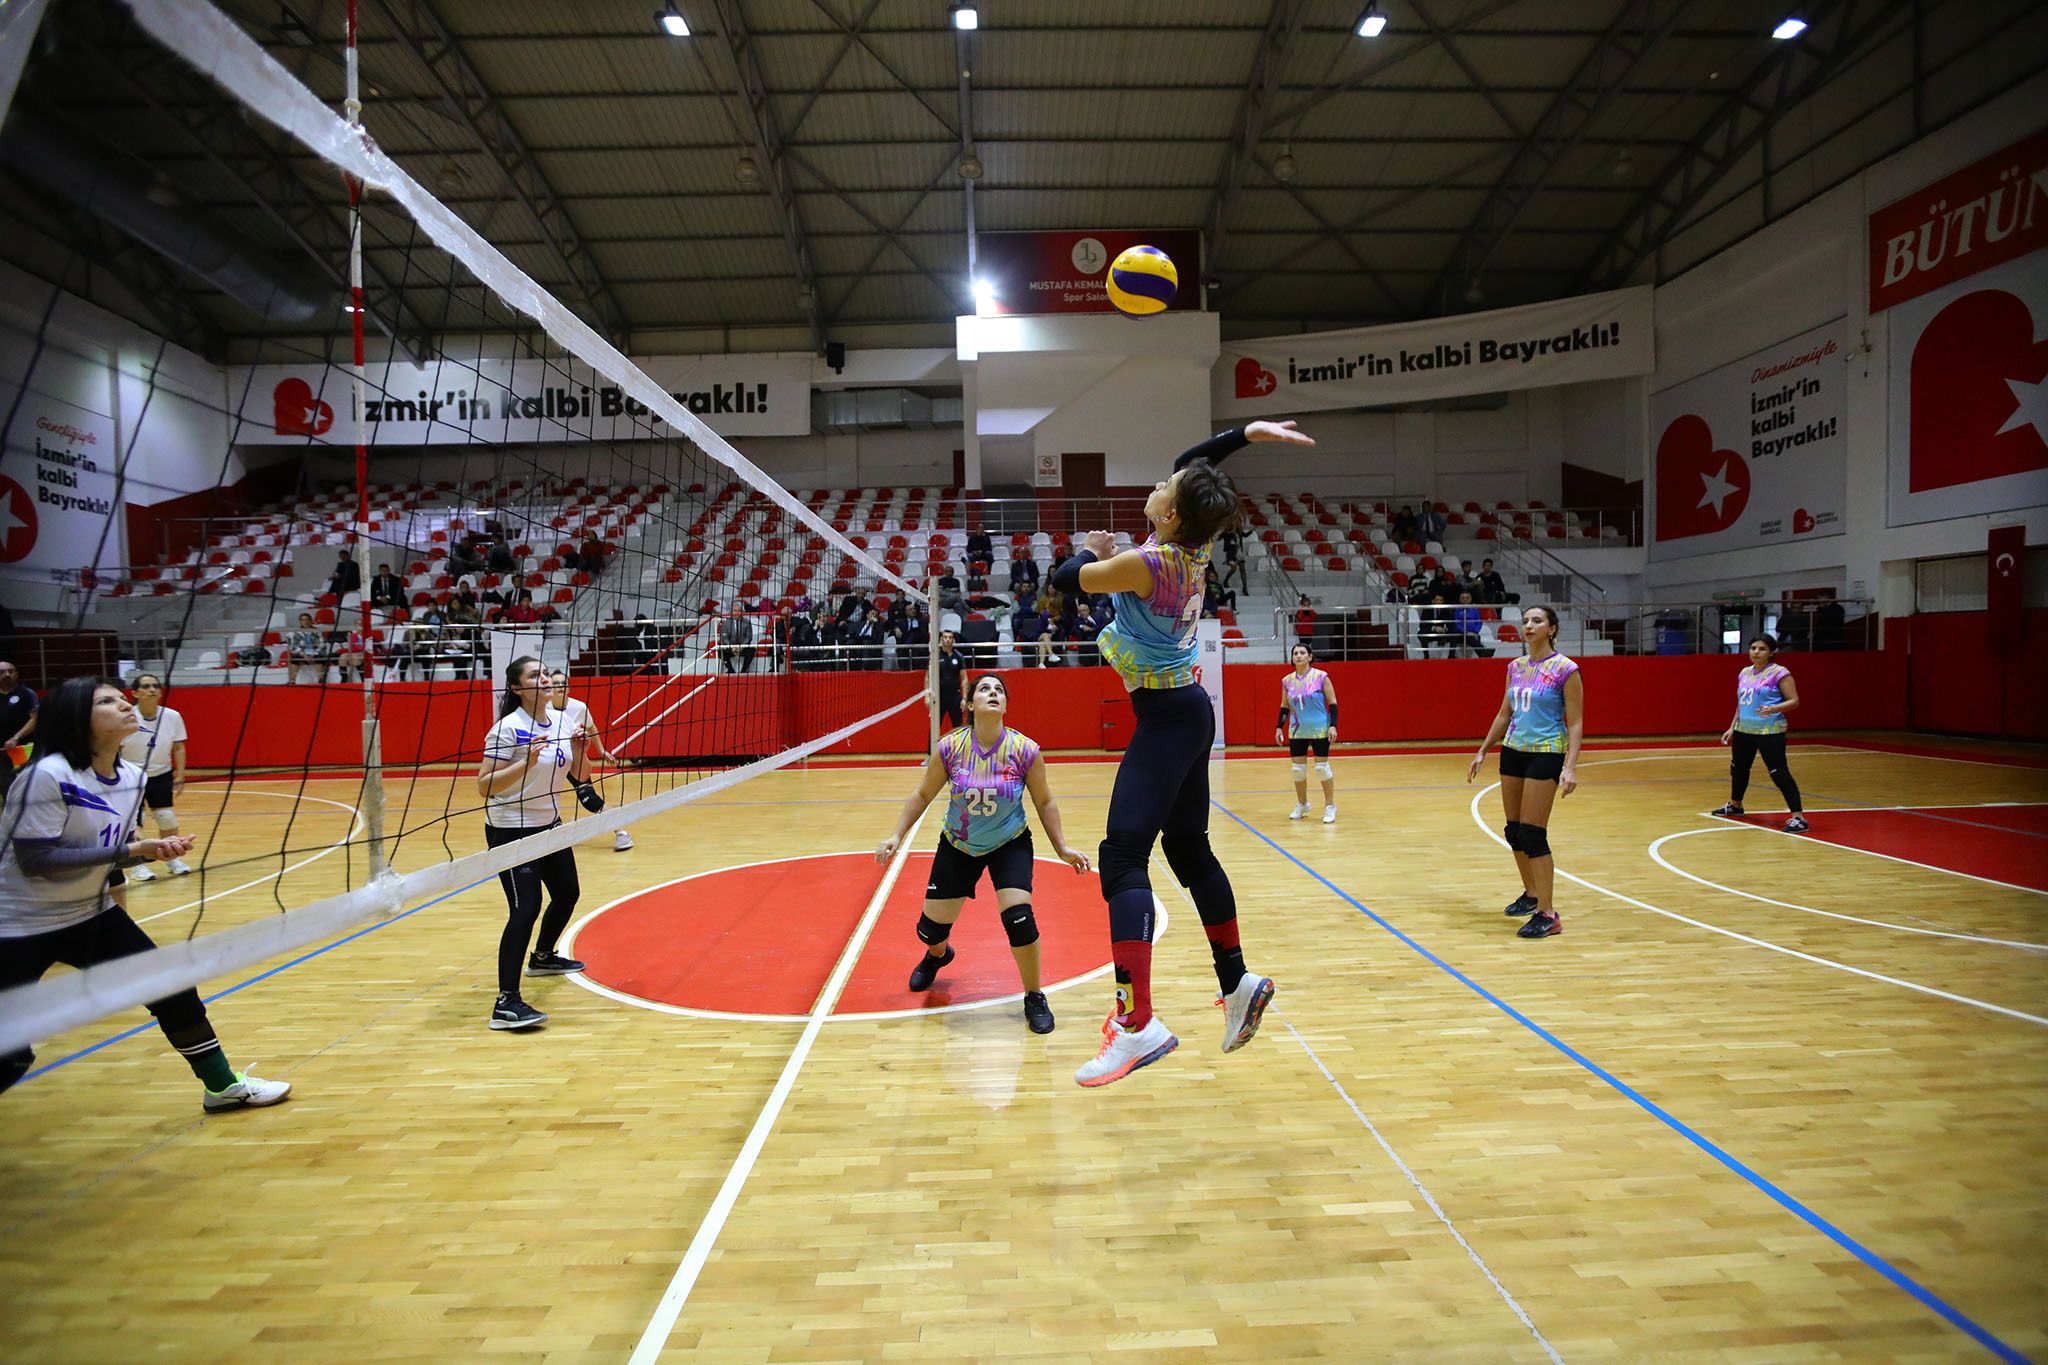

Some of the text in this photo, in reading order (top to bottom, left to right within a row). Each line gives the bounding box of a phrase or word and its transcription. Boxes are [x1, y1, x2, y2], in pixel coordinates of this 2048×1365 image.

[1029, 280, 1107, 291] MUSTAFA KEMAL
[1063, 292, 1083, 304] Spor
[1288, 322, 1620, 384] İzmir'in kalbi Bayraklı!
[1750, 340, 1838, 384] Dinamizmiyle
[502, 386, 590, 419] kalbi
[600, 382, 768, 423] Baraklı!
[1751, 378, 1820, 415] İzmir'in
[1751, 406, 1795, 437] kalbi
[1751, 417, 1837, 459] Bayraklı!
[36, 437, 97, 473] İzmir'in
[37, 463, 78, 489] kalbi
[38, 485, 109, 516] Bayraklı!
[1511, 686, 1532, 713] 10
[1740, 687, 1754, 705] 23
[556, 747, 566, 768] 8
[965, 787, 998, 817] 25
[99, 822, 121, 848] 11
